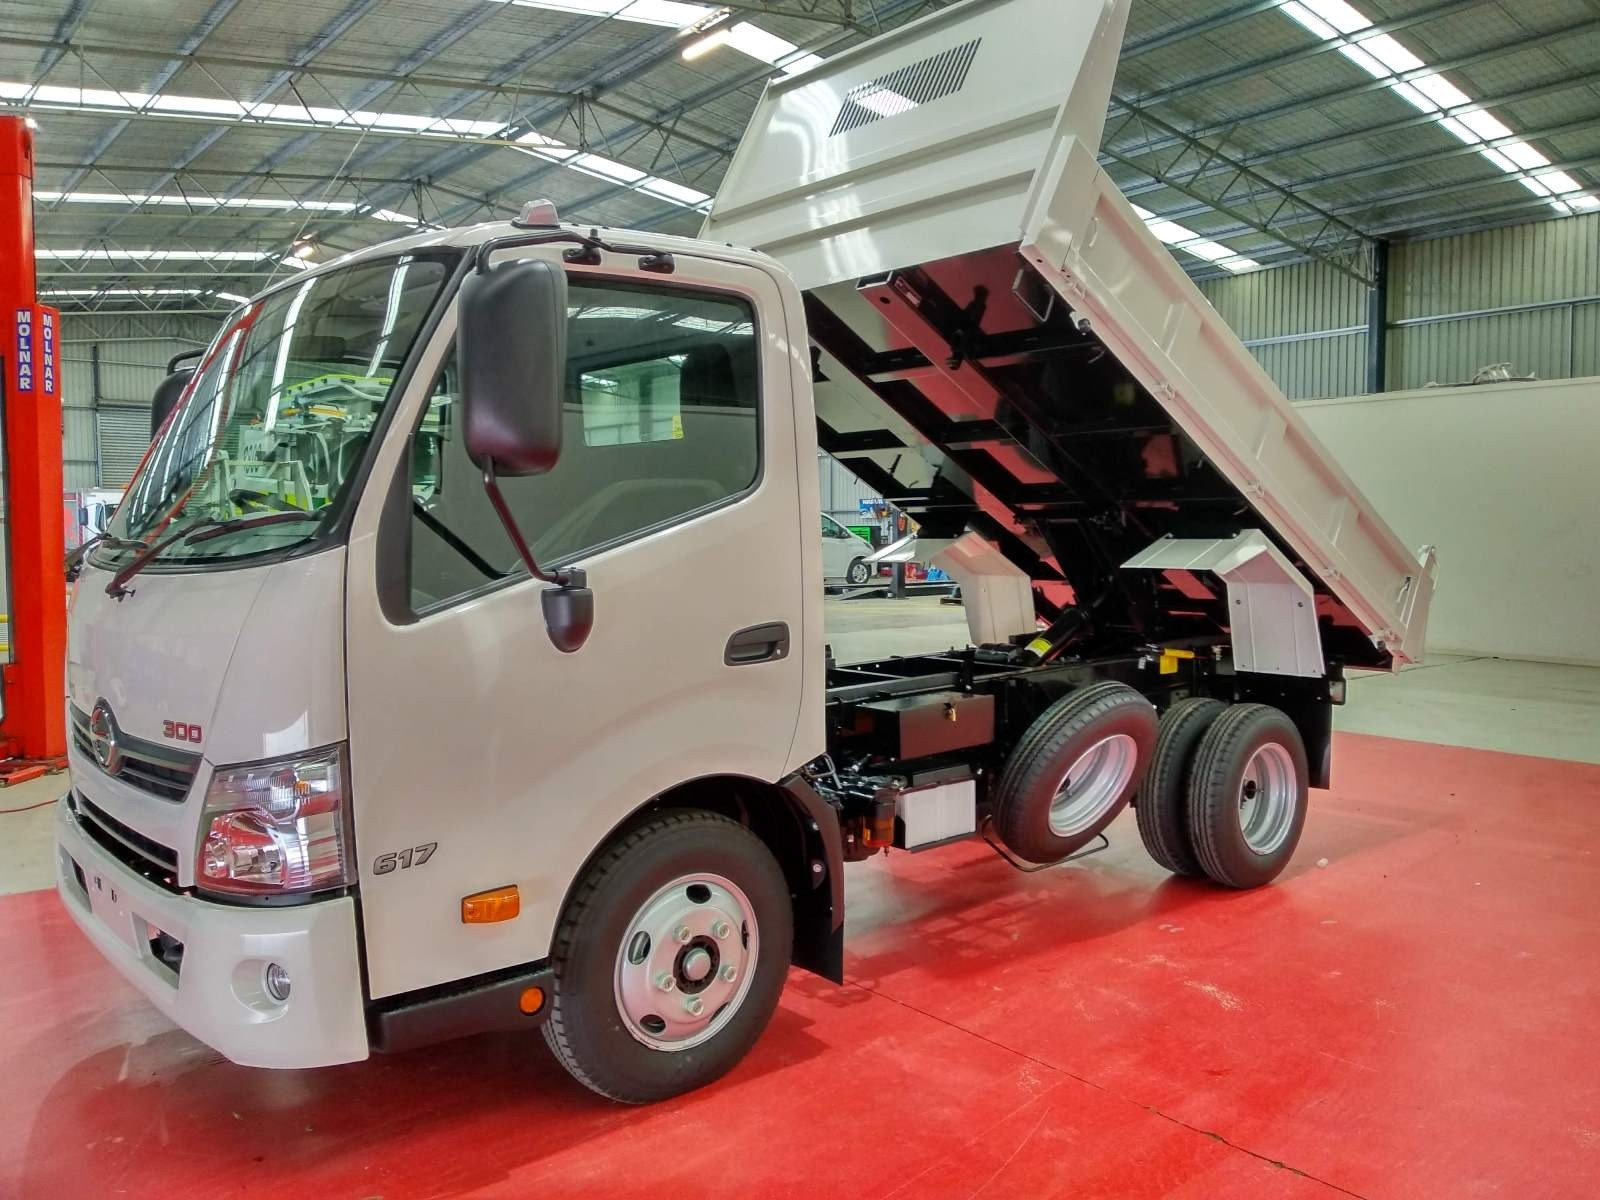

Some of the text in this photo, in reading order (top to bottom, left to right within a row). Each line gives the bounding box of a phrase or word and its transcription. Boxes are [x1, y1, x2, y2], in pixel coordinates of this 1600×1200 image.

[17, 311, 31, 389] MOLNAR
[43, 314, 53, 392] MOLNAR
[163, 720, 202, 743] 300
[373, 842, 438, 875] 617
